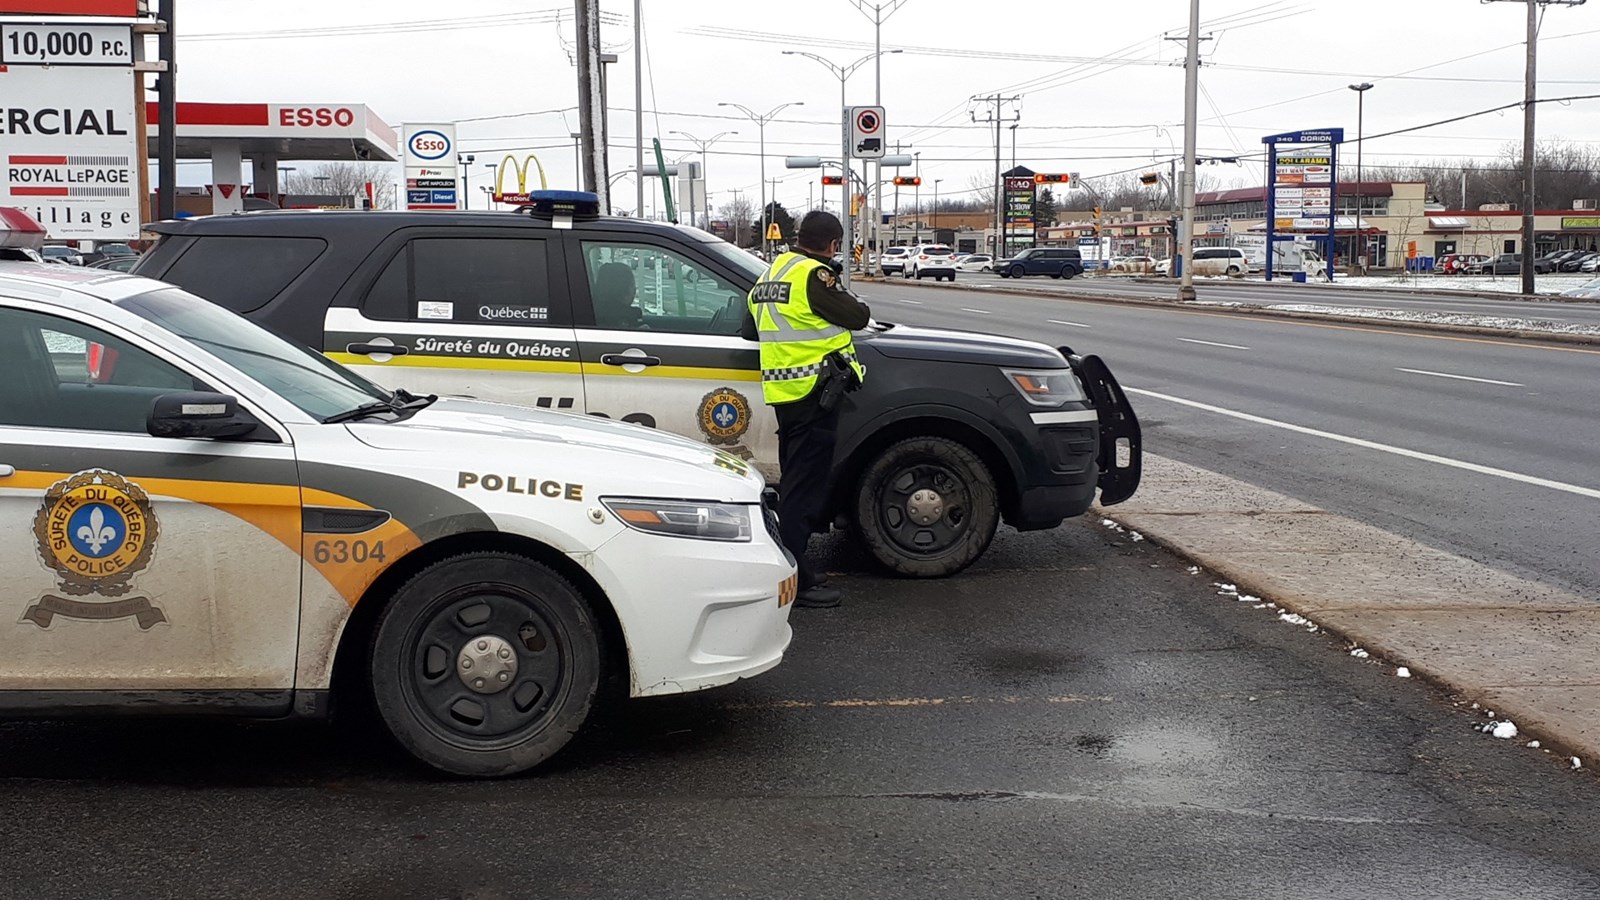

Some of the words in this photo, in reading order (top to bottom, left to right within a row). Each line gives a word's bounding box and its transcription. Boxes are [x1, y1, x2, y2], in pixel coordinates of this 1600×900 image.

[8, 31, 93, 60] 10,000
[101, 40, 128, 56] P.C.
[0, 108, 127, 135] RCIAL
[279, 108, 354, 127] ESSO
[415, 138, 445, 151] Esso
[1279, 157, 1328, 165] DOLLARAMA
[9, 168, 64, 183] ROYAL
[13, 205, 131, 228] illage
[752, 284, 788, 302] POLICE
[479, 305, 529, 319] Québec
[414, 337, 473, 353] Sûreté
[478, 341, 501, 355] du
[505, 342, 571, 358] Québec
[711, 425, 736, 435] POLICE
[457, 471, 584, 502] POLICE
[85, 488, 107, 501] DU
[113, 495, 142, 553] QUÉBEC
[313, 540, 386, 564] 6304
[66, 554, 127, 574] POLICE
